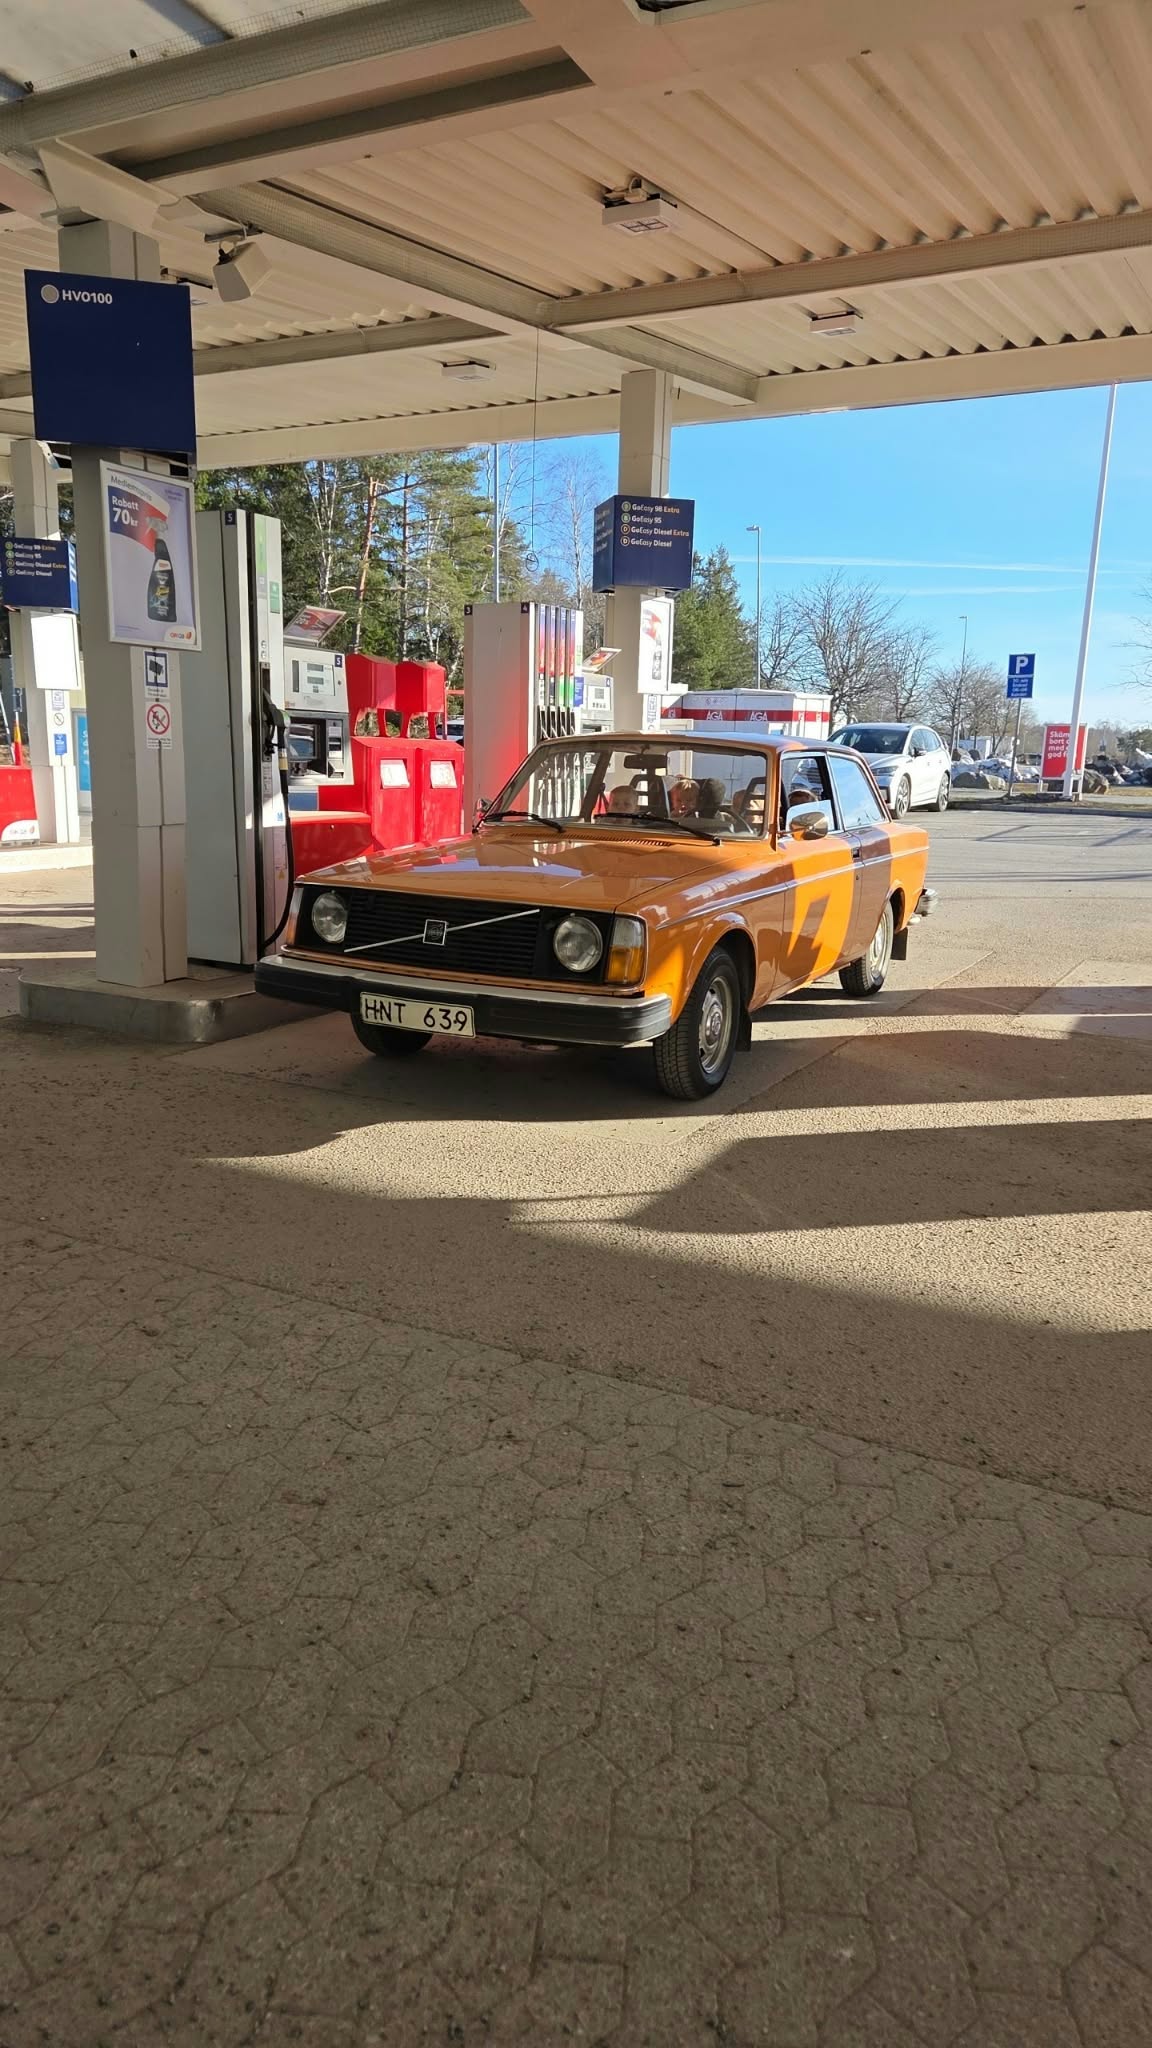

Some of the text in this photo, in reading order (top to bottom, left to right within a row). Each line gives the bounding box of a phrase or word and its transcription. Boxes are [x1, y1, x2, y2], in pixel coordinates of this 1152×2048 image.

[62, 289, 113, 304] HVO100
[112, 495, 139, 510] Rabatt
[632, 503, 653, 513] GoEasy
[664, 506, 680, 514] Extra
[228, 513, 233, 522] 5
[631, 515, 653, 524] GoEasy
[631, 527, 652, 536] GoEasy
[653, 527, 672, 535] Diesel
[631, 538, 652, 547] GoEasy
[653, 539, 672, 547] Diesel
[1015, 656, 1029, 674] P
[706, 711, 723, 721] AGA
[750, 711, 768, 722] AGA
[1047, 751, 1062, 760] god
[365, 998, 467, 1031] HNT 639
